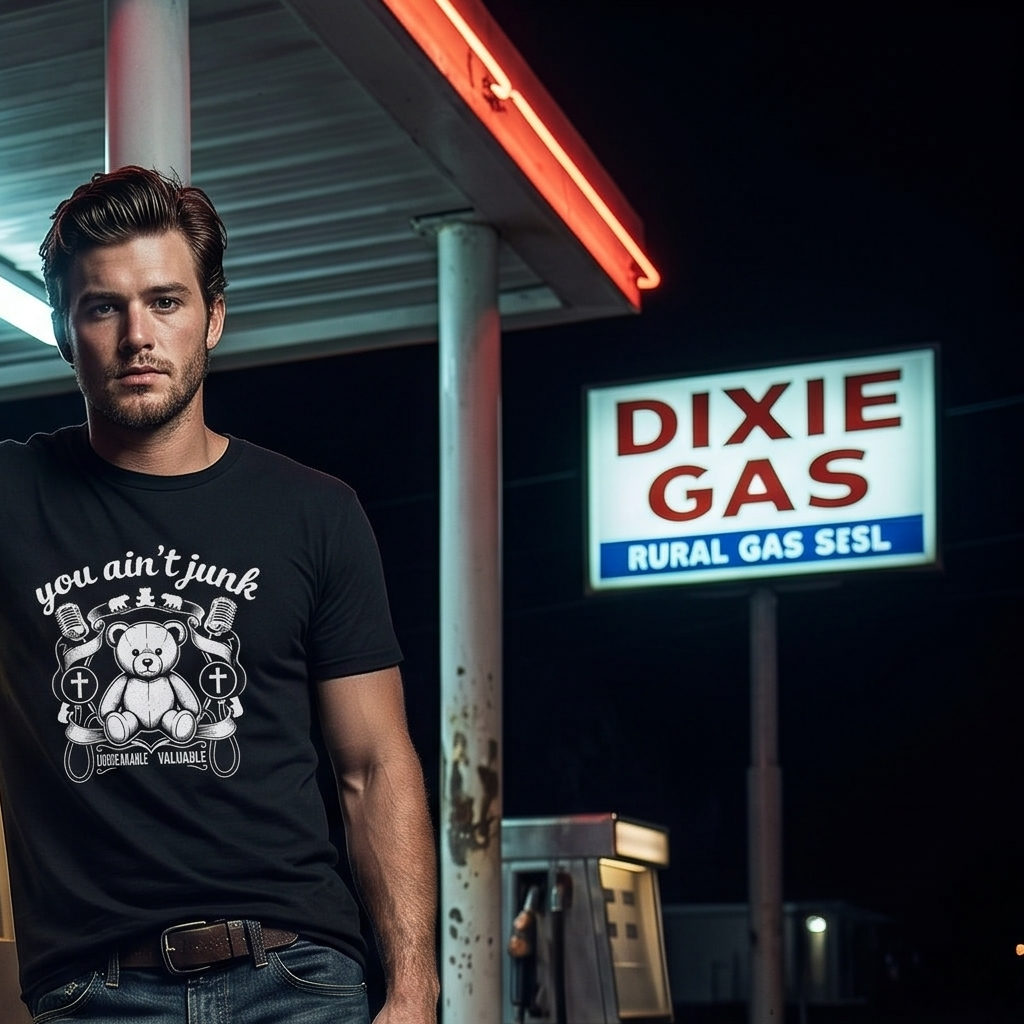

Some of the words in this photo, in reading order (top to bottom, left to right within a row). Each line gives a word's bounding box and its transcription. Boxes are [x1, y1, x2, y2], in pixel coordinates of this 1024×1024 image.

[616, 369, 902, 457] DIXIE
[648, 448, 869, 522] GAS
[35, 566, 98, 616] you
[103, 544, 181, 581] ain't
[174, 553, 260, 600] junk
[627, 538, 729, 572] RURAL
[738, 530, 804, 563] GAS
[814, 524, 892, 556] SESL
[157, 750, 207, 765] VALUABLE
